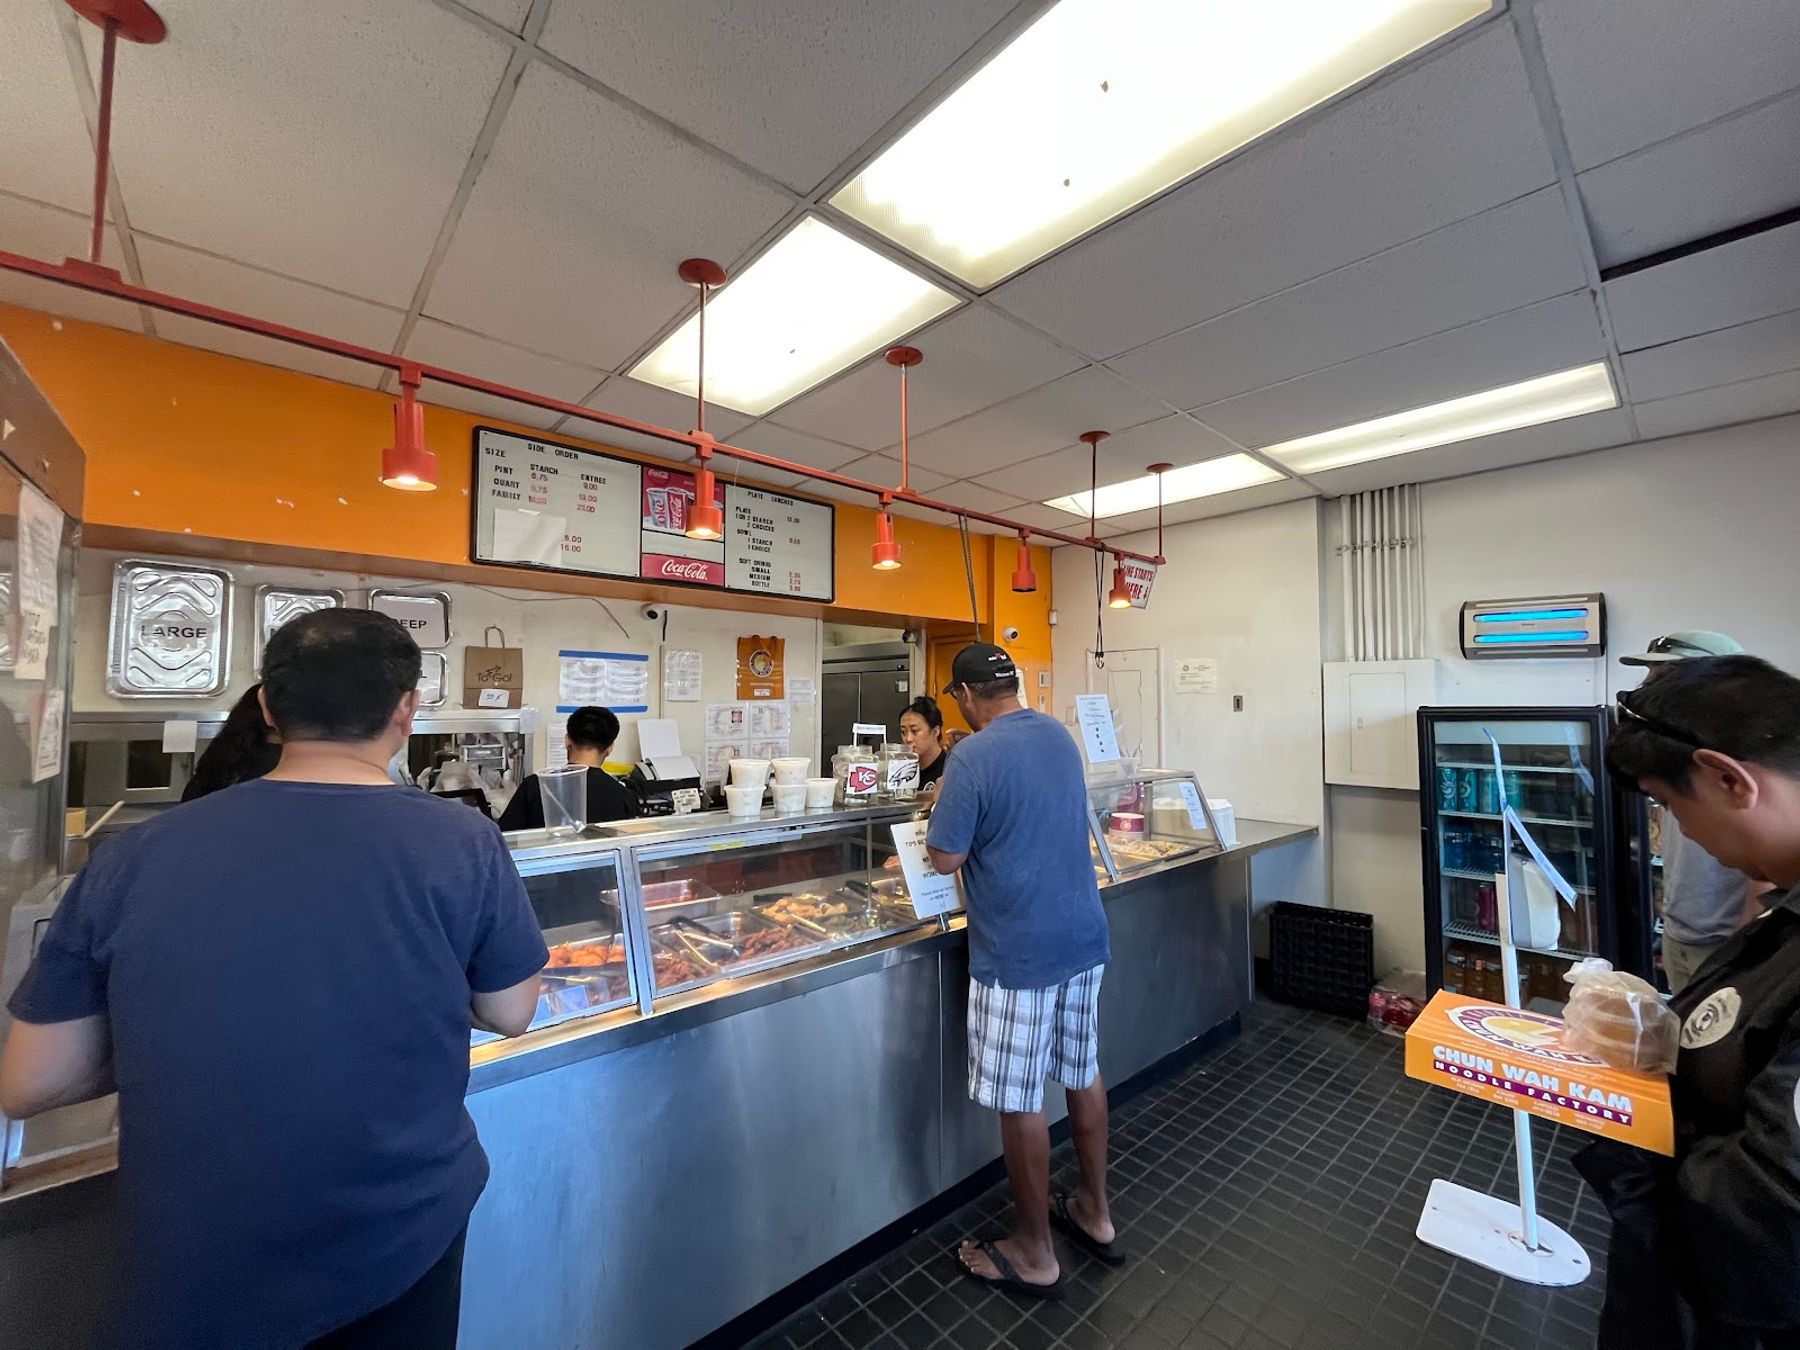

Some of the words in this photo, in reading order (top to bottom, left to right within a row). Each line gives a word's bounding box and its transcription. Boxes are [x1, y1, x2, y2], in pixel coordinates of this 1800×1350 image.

[485, 447, 506, 458] SIZE
[527, 443, 545, 454] SIDE
[554, 449, 579, 460] ORDER
[494, 464, 513, 475] PINT
[531, 473, 549, 482] 6.75
[529, 463, 559, 475] STARCH
[580, 473, 606, 485] ENTREE
[493, 478, 520, 489] QUART
[491, 489, 521, 500] FAMILY
[747, 491, 763, 500] PLATE
[735, 506, 751, 514] PLATE
[737, 528, 752, 536] BOWL
[751, 544, 771, 553] CHOICE
[661, 559, 708, 581] Coca-Cola
[751, 566, 770, 574] SMALL
[1133, 567, 1154, 582] STARTS
[749, 573, 771, 581] MEDIUM
[751, 580, 770, 588] BOTTLE
[400, 619, 428, 630] EEP
[141, 624, 207, 639] LARGE
[1433, 1045, 1494, 1074] CHUN
[1502, 1062, 1559, 1092] WAH
[1569, 1081, 1633, 1113] KAM
[1435, 1062, 1513, 1090] NOODLE
[1527, 1088, 1630, 1124] FACTORY
